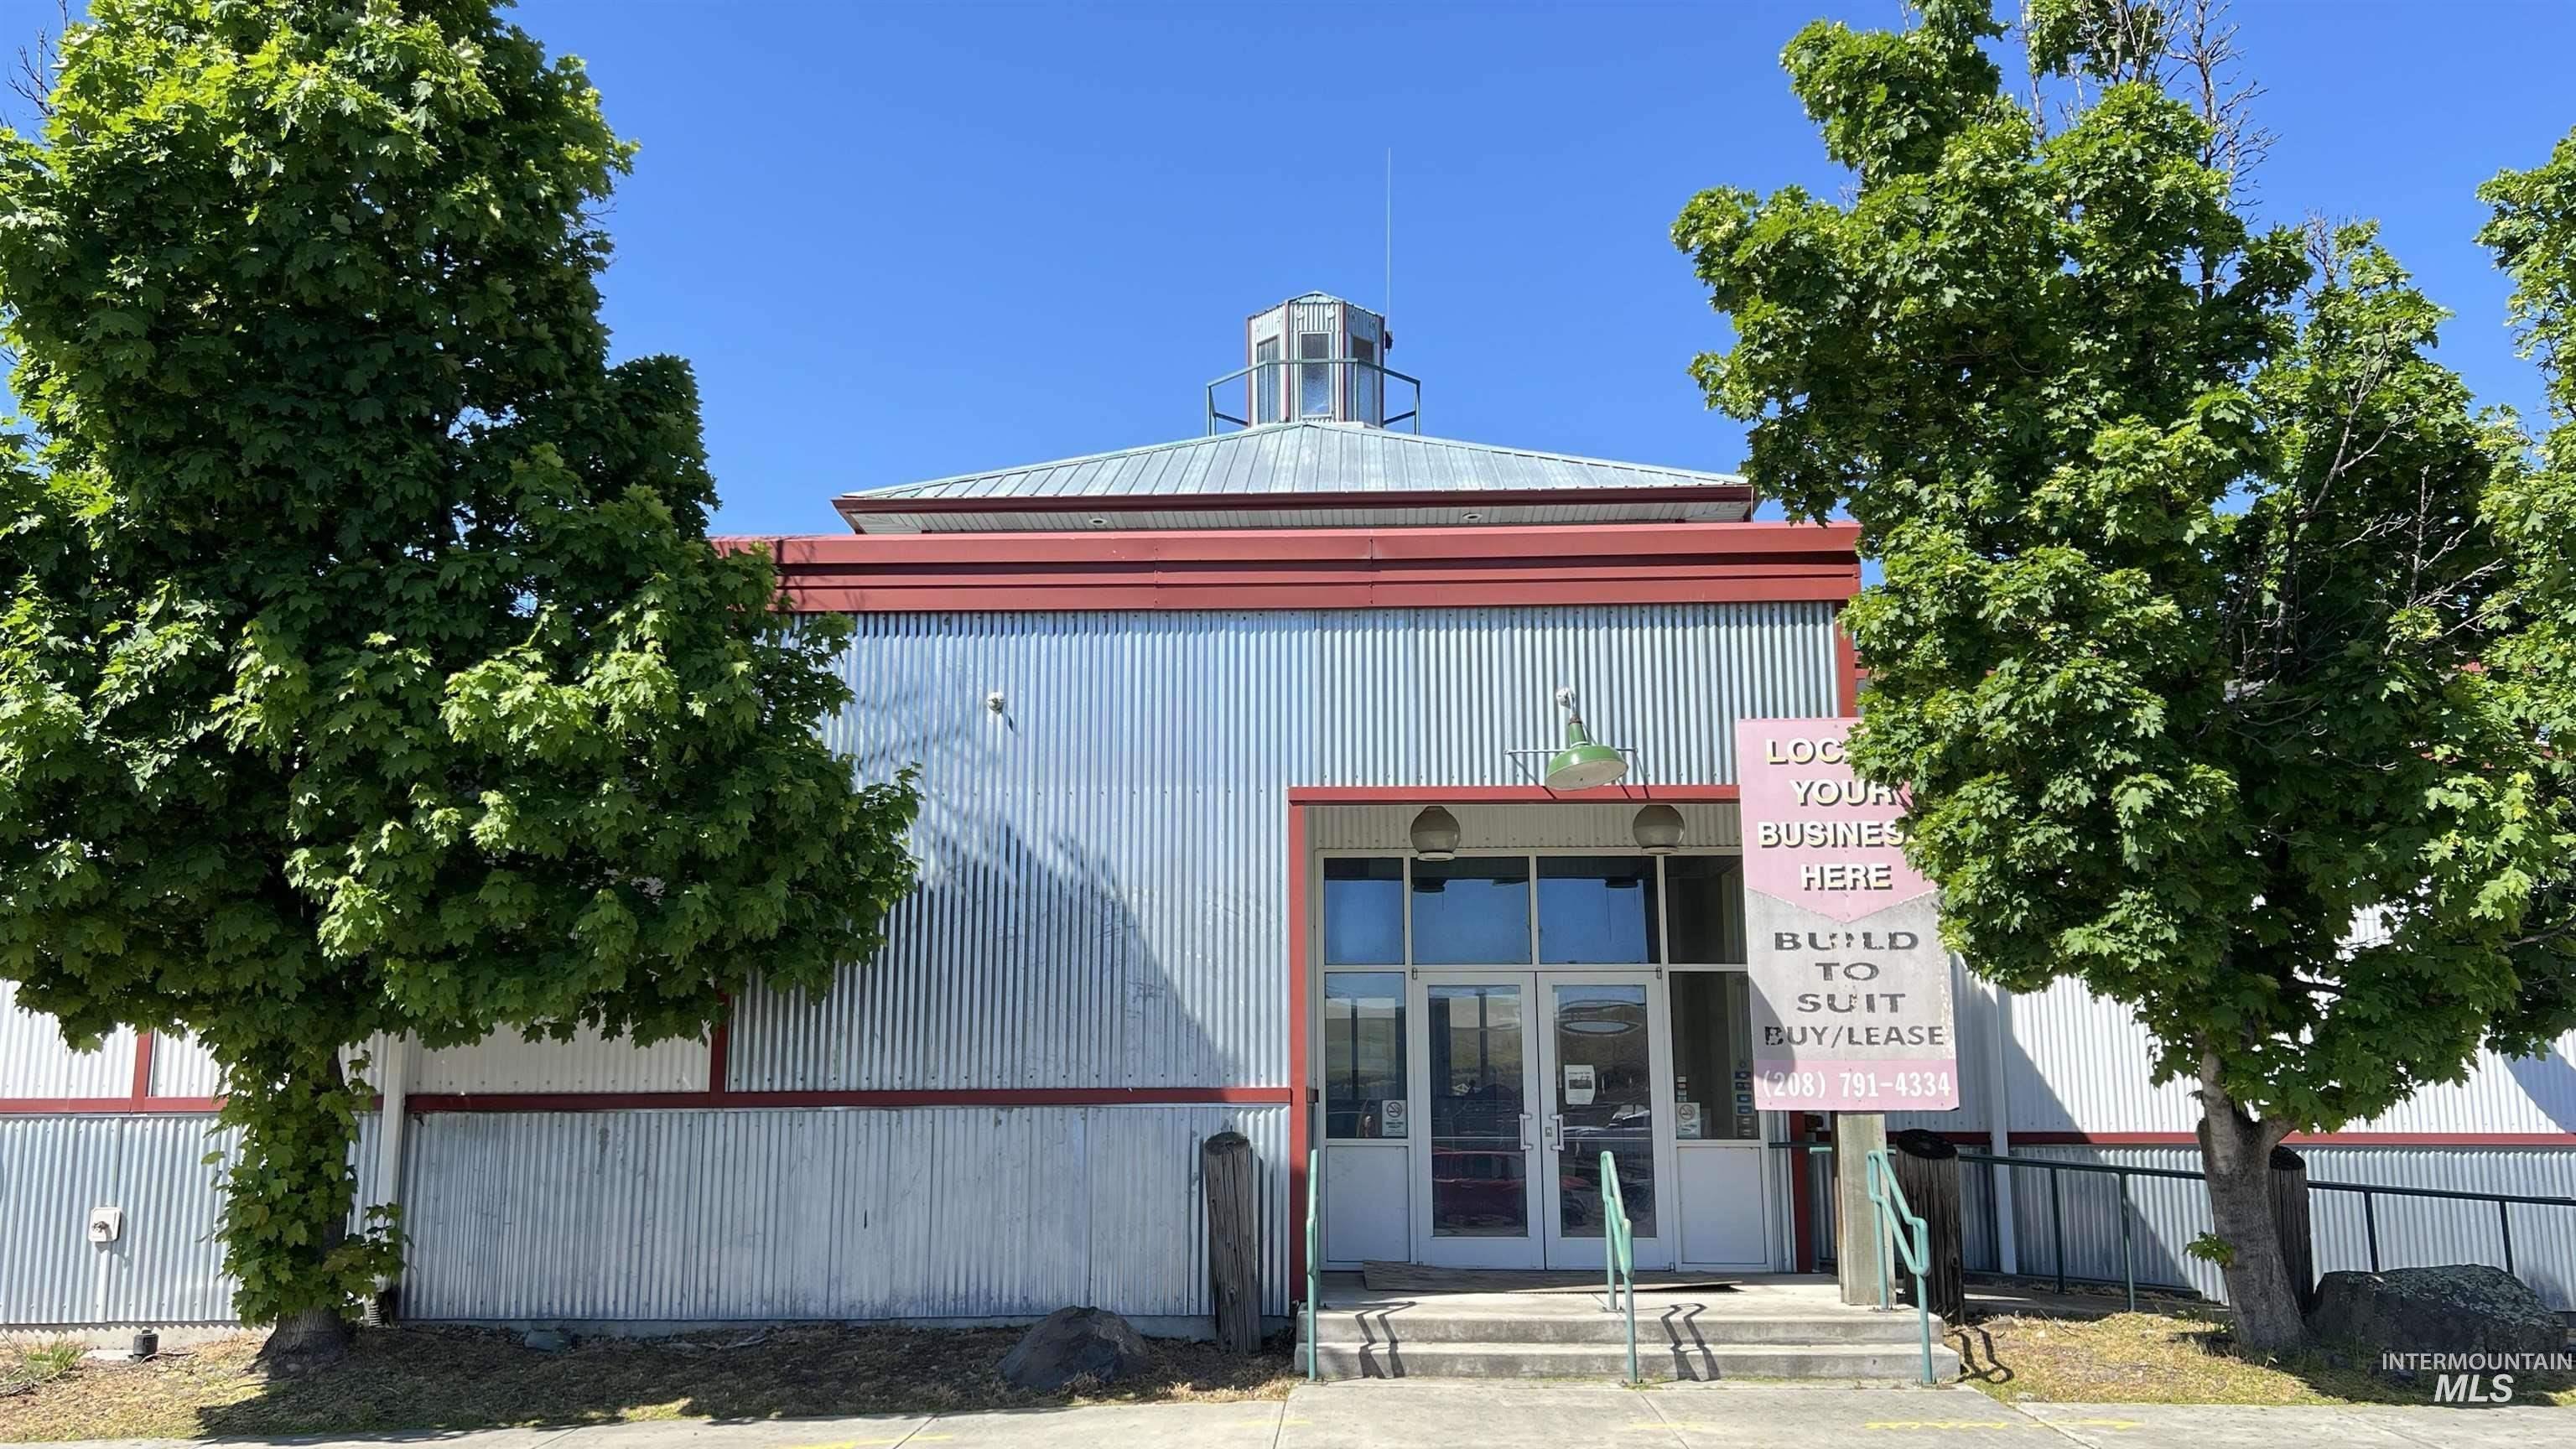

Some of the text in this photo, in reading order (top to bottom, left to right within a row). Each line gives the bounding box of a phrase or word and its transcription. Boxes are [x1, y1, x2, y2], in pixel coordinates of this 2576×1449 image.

[1766, 737, 1850, 765] LOC
[1789, 778, 1898, 806] YOUR
[1758, 820, 1915, 848] BUSINES
[1800, 863, 1893, 891] HERE
[1774, 932, 1919, 951] BUILD
[1815, 962, 1879, 981] TO
[1797, 993, 1906, 1013] SUIT
[1764, 1026, 1945, 1048] BUY/LEASE
[1762, 1070, 1951, 1098] (208) 791-4334
